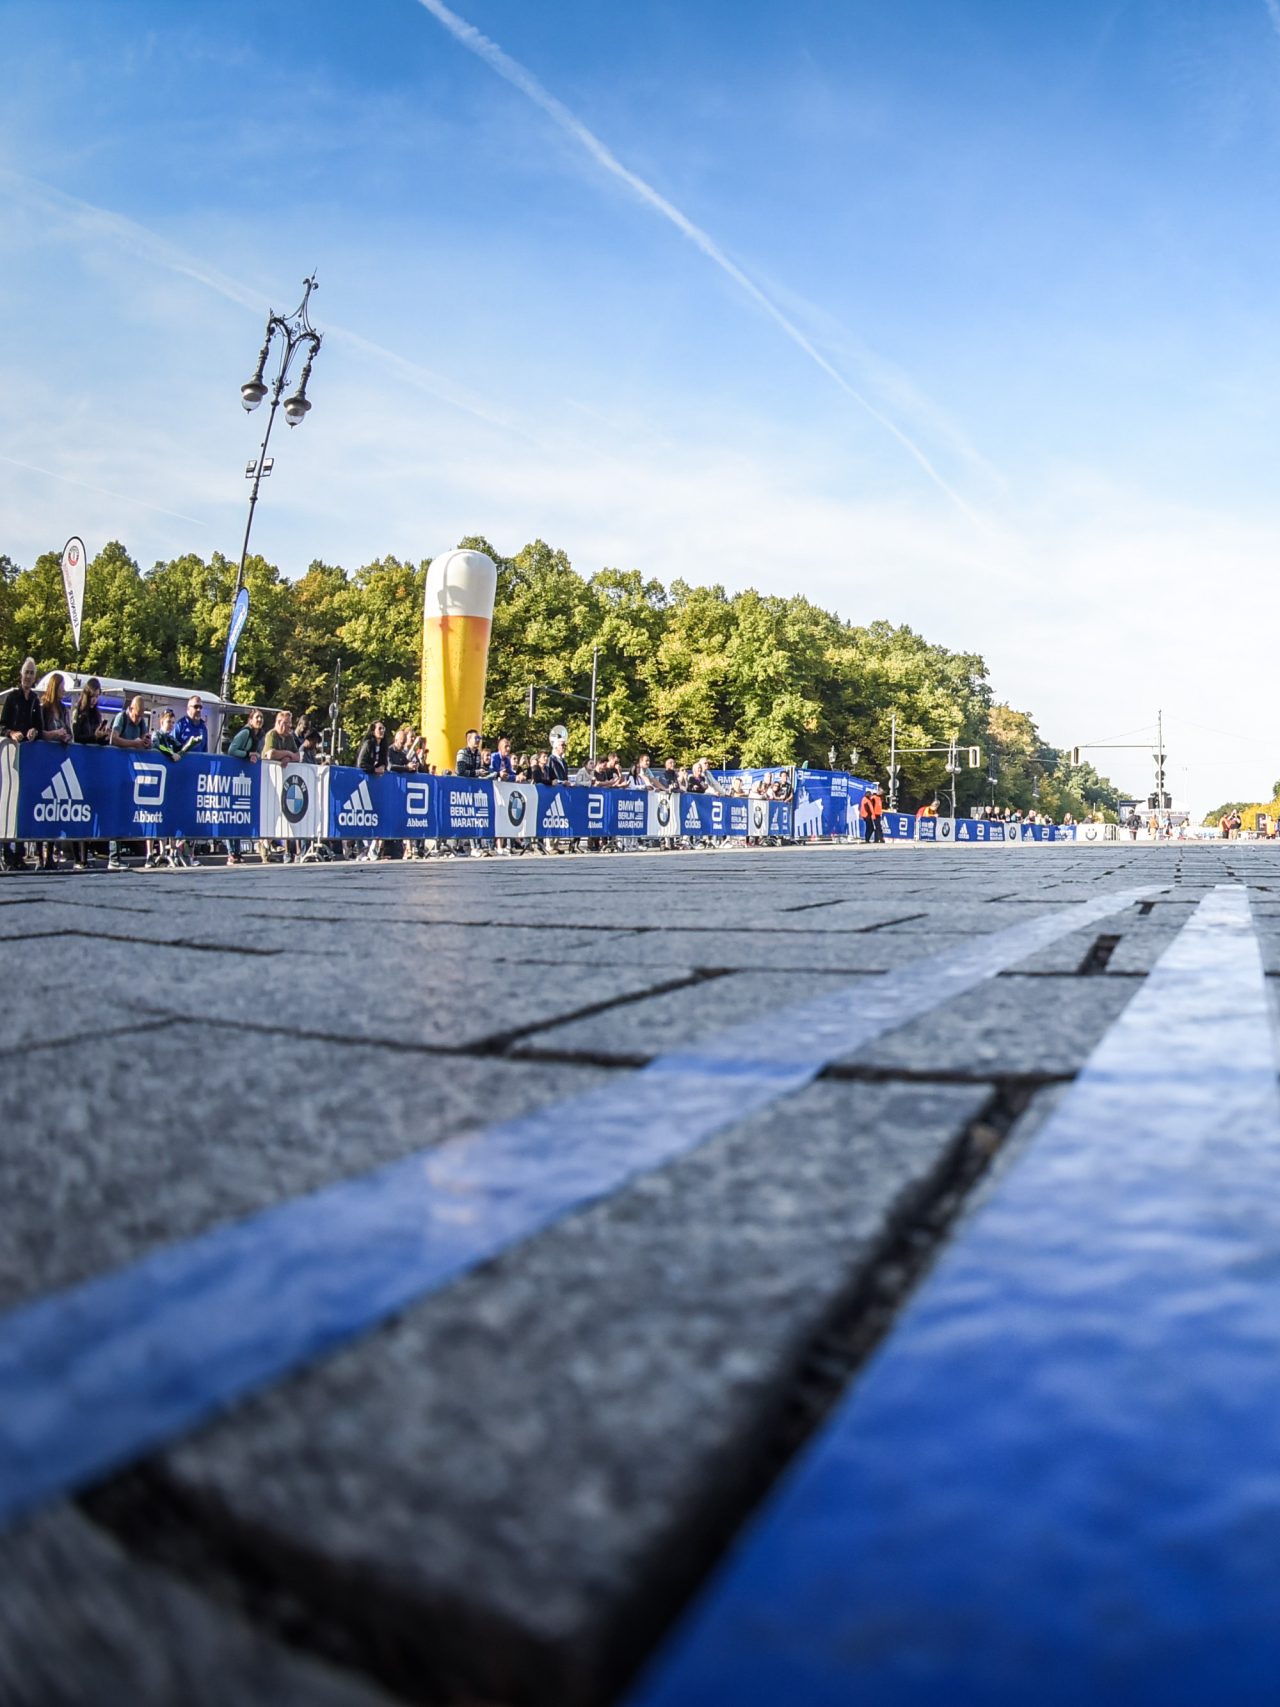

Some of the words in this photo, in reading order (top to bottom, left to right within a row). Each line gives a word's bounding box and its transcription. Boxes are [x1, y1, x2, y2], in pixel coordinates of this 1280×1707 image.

[197, 774, 230, 793] BMW
[197, 795, 230, 810] BERLIN
[450, 791, 473, 805] BMW
[34, 799, 91, 823] adidas
[133, 810, 162, 824] Abbott
[196, 811, 251, 824] MARATHON
[338, 808, 378, 827] adidas
[450, 807, 475, 817] BERLIN
[406, 817, 428, 828] Abbott
[451, 818, 489, 828] MARATHON
[543, 815, 569, 829] adidas
